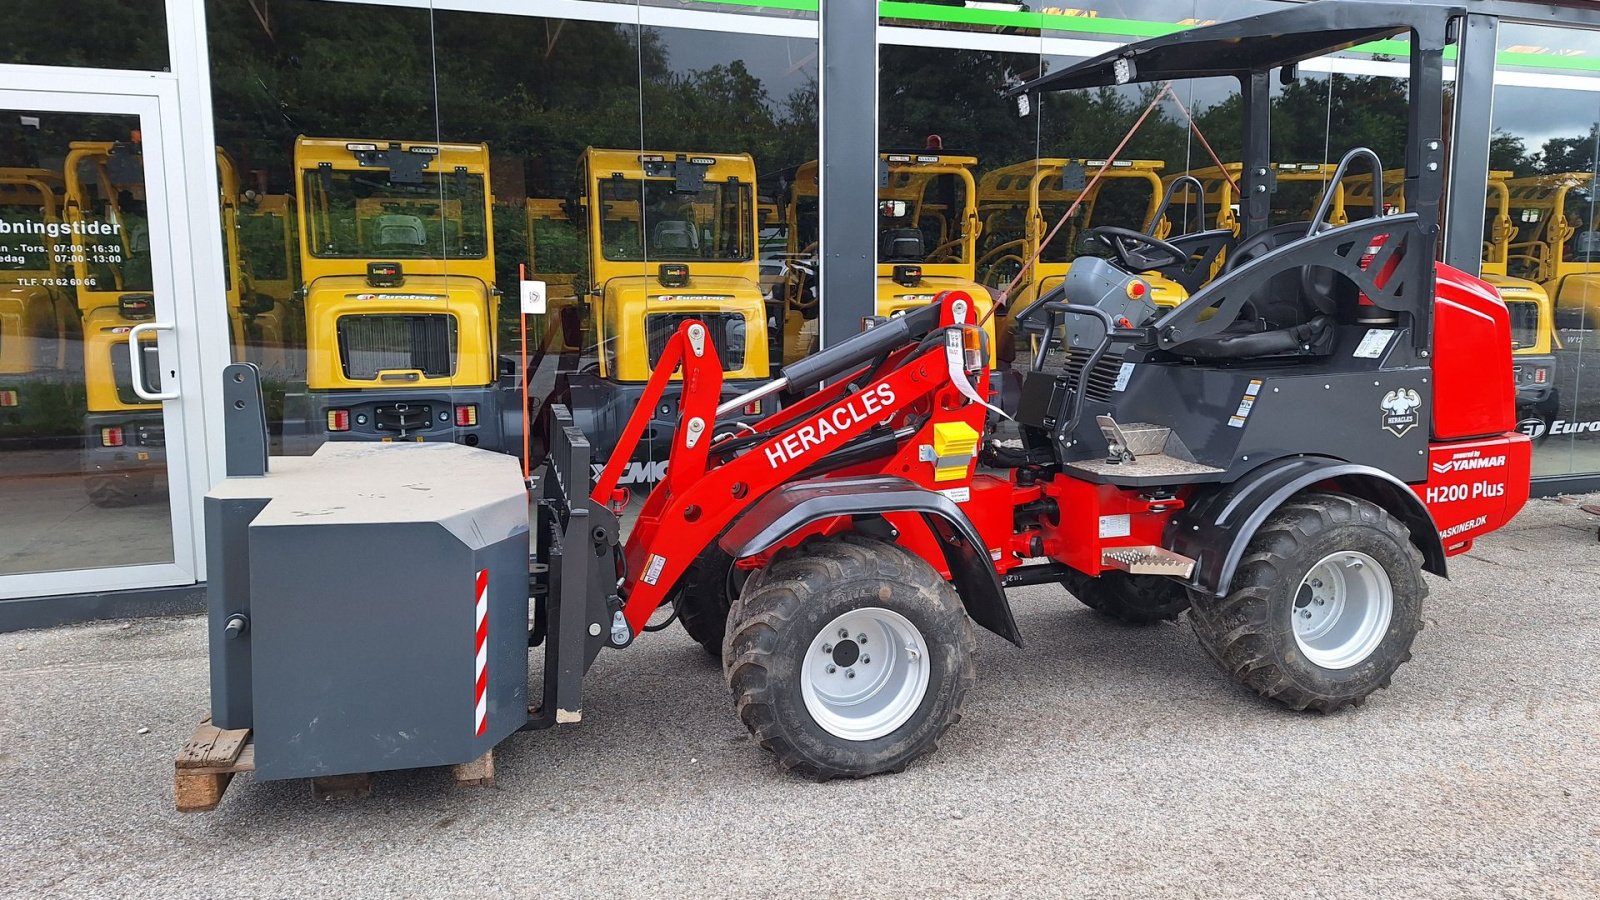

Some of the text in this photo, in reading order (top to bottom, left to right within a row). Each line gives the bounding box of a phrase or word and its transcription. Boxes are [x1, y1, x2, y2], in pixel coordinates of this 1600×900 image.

[20, 244, 48, 253] Tors.
[54, 244, 83, 253] 07:00
[92, 244, 121, 253] 16:30
[54, 254, 84, 263] 07:00
[93, 254, 121, 263] 13:00
[17, 278, 96, 286] TLF. 73 62 60 66
[1387, 415, 1413, 424] HERACLES
[764, 383, 896, 469] HERACLES
[1453, 455, 1506, 471] YANMAR
[1426, 480, 1504, 504] H200 Plus
